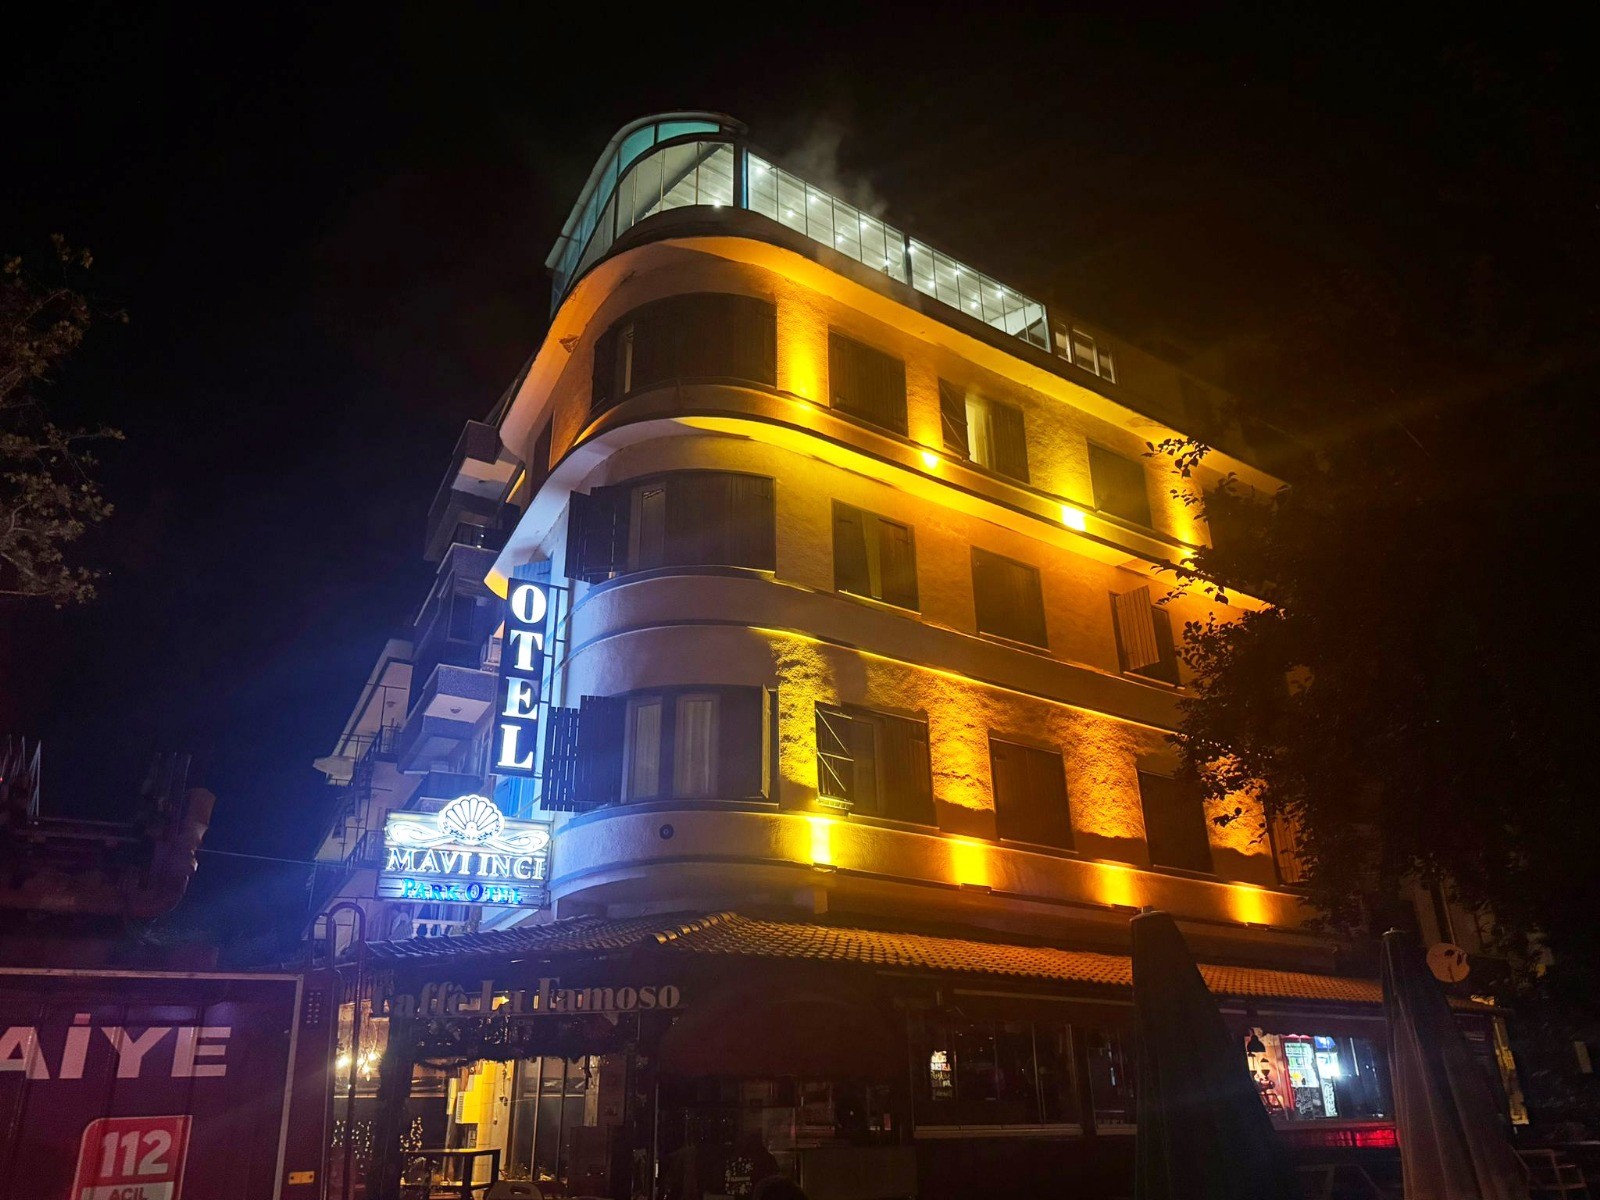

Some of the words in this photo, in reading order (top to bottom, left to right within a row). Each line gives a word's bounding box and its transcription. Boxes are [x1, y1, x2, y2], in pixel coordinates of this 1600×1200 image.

[497, 584, 547, 769] OTEL
[385, 847, 473, 875] MAVI
[538, 977, 681, 1013] Famoso
[0, 1013, 232, 1080] AİYE
[100, 1129, 172, 1177] 112
